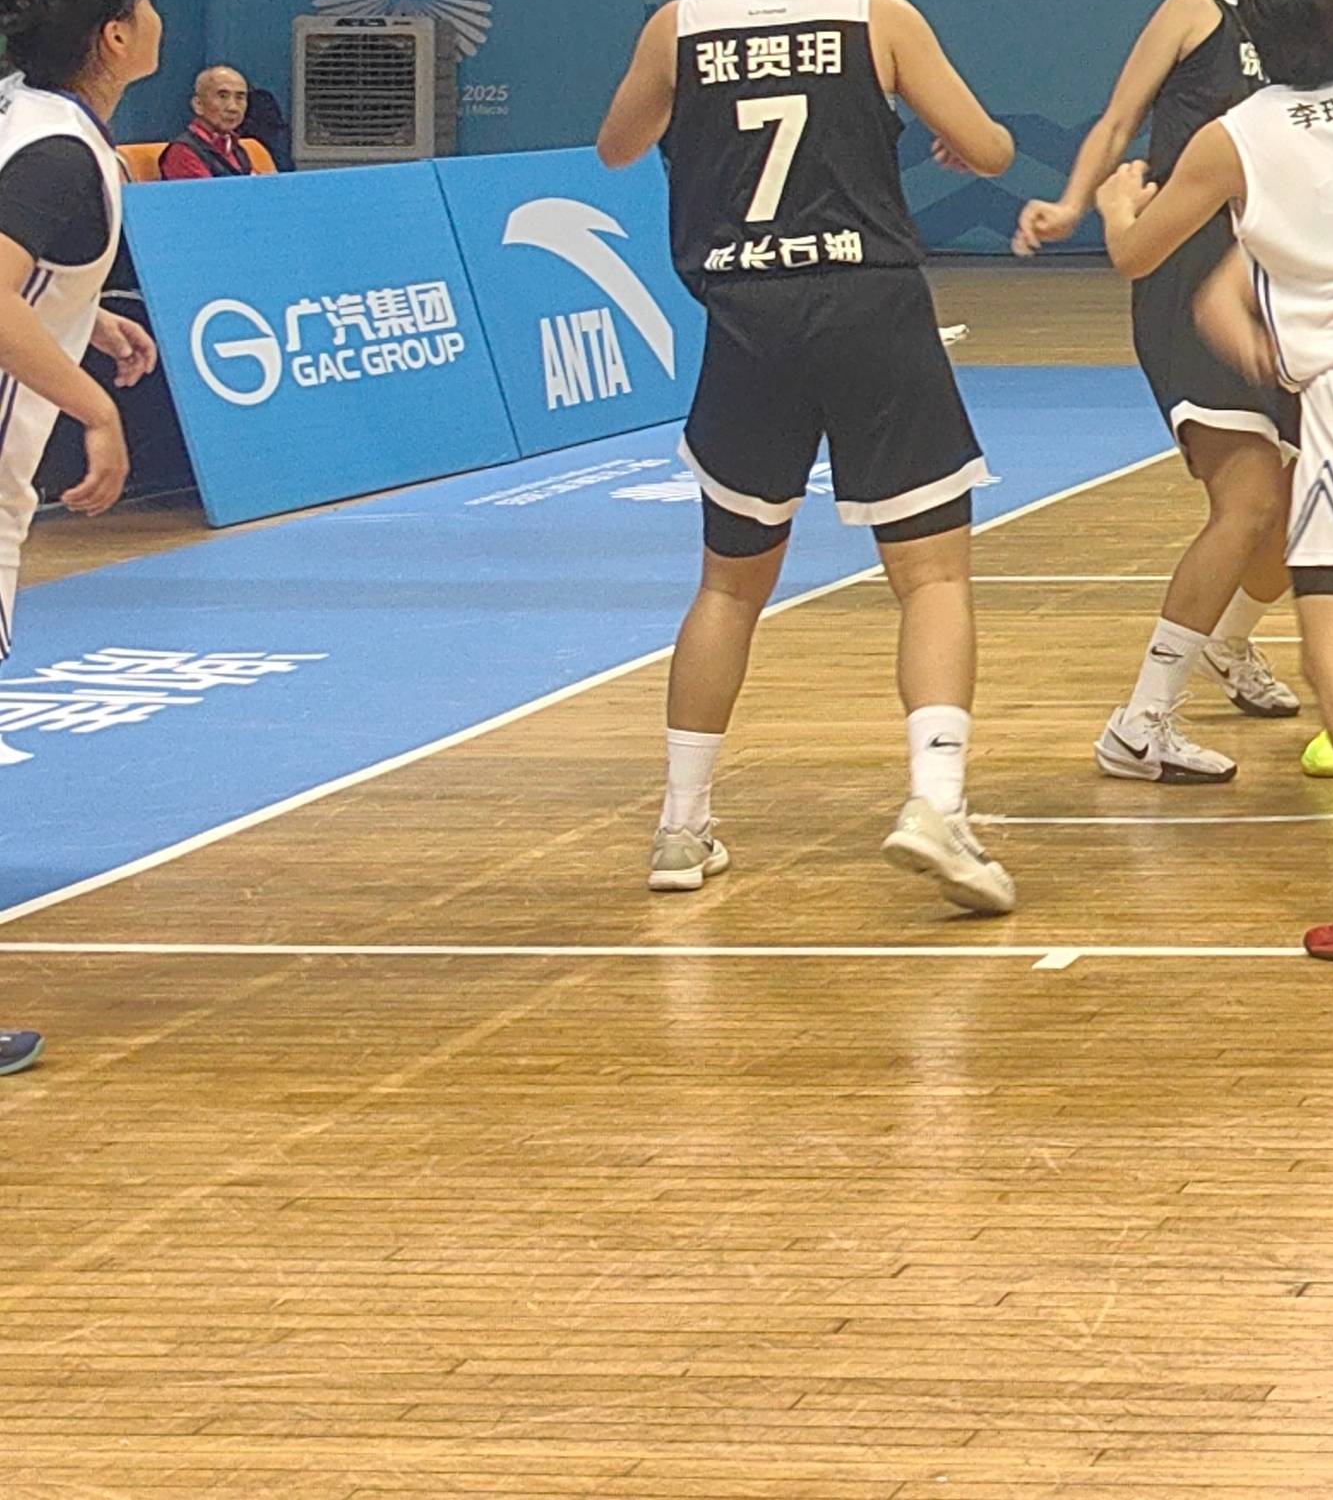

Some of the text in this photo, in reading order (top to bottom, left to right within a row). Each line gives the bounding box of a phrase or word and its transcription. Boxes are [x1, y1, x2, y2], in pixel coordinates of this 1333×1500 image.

[696, 31, 842, 84] 张贺玥
[462, 85, 508, 101] 2025
[736, 94, 808, 222] 7
[703, 229, 864, 271] 延长石油
[285, 280, 458, 352] 广汽集团
[291, 332, 465, 387] GAC GROUP
[540, 307, 633, 411] ANTA
